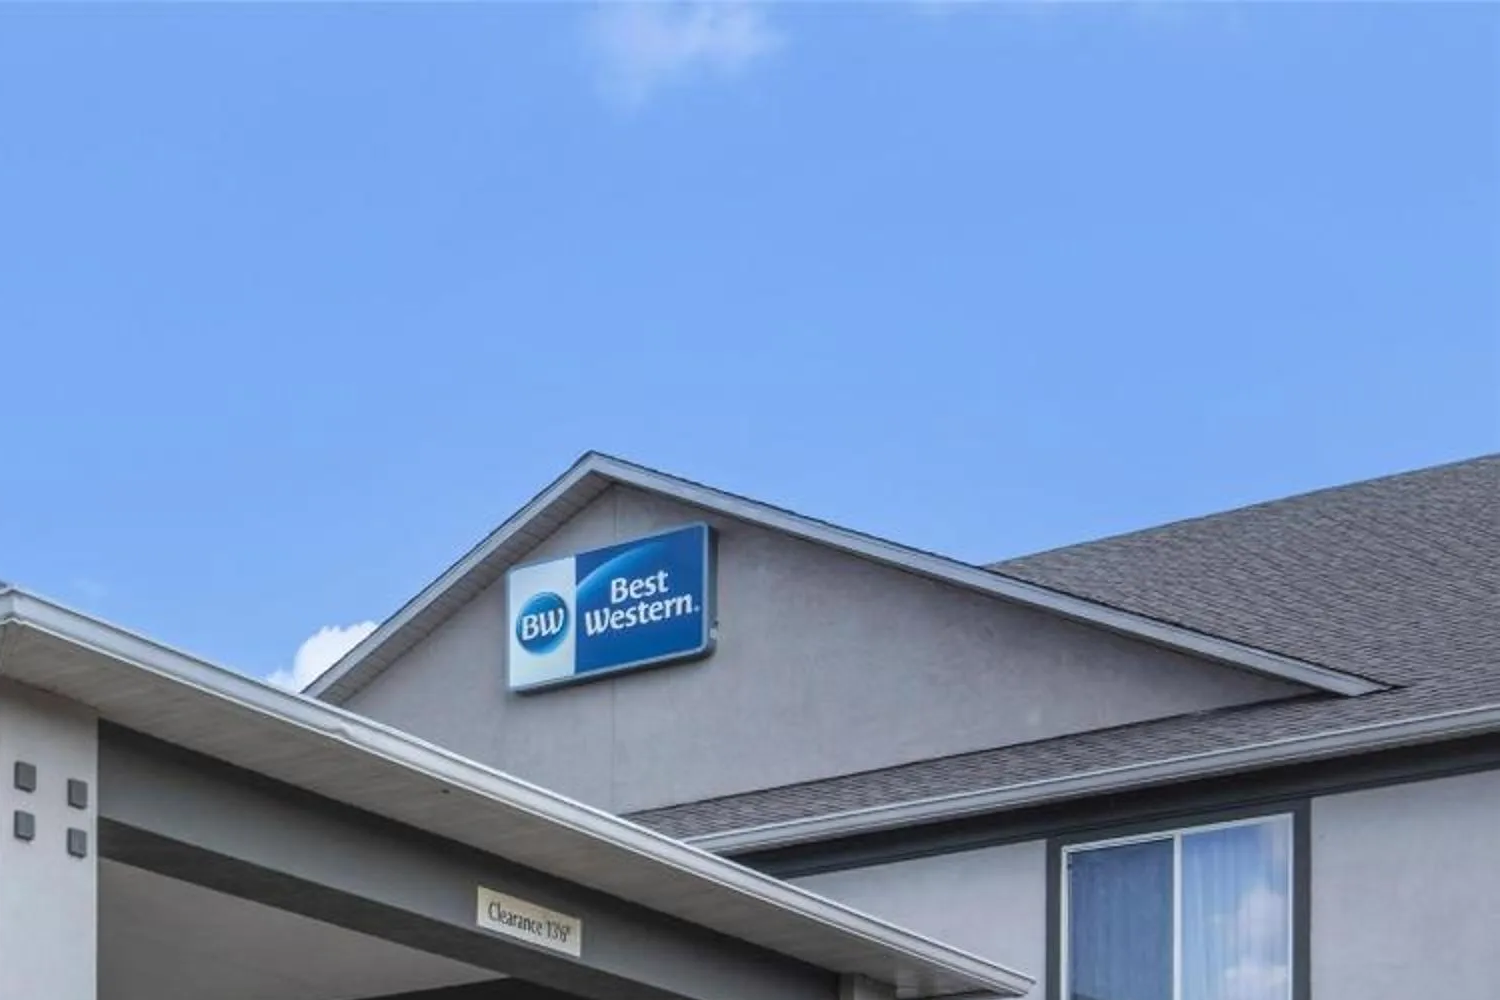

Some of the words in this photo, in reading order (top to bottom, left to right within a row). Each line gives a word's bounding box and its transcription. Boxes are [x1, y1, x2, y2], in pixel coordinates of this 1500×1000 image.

[610, 569, 669, 604] Best
[521, 606, 565, 641] BW
[487, 901, 543, 937] Clearance
